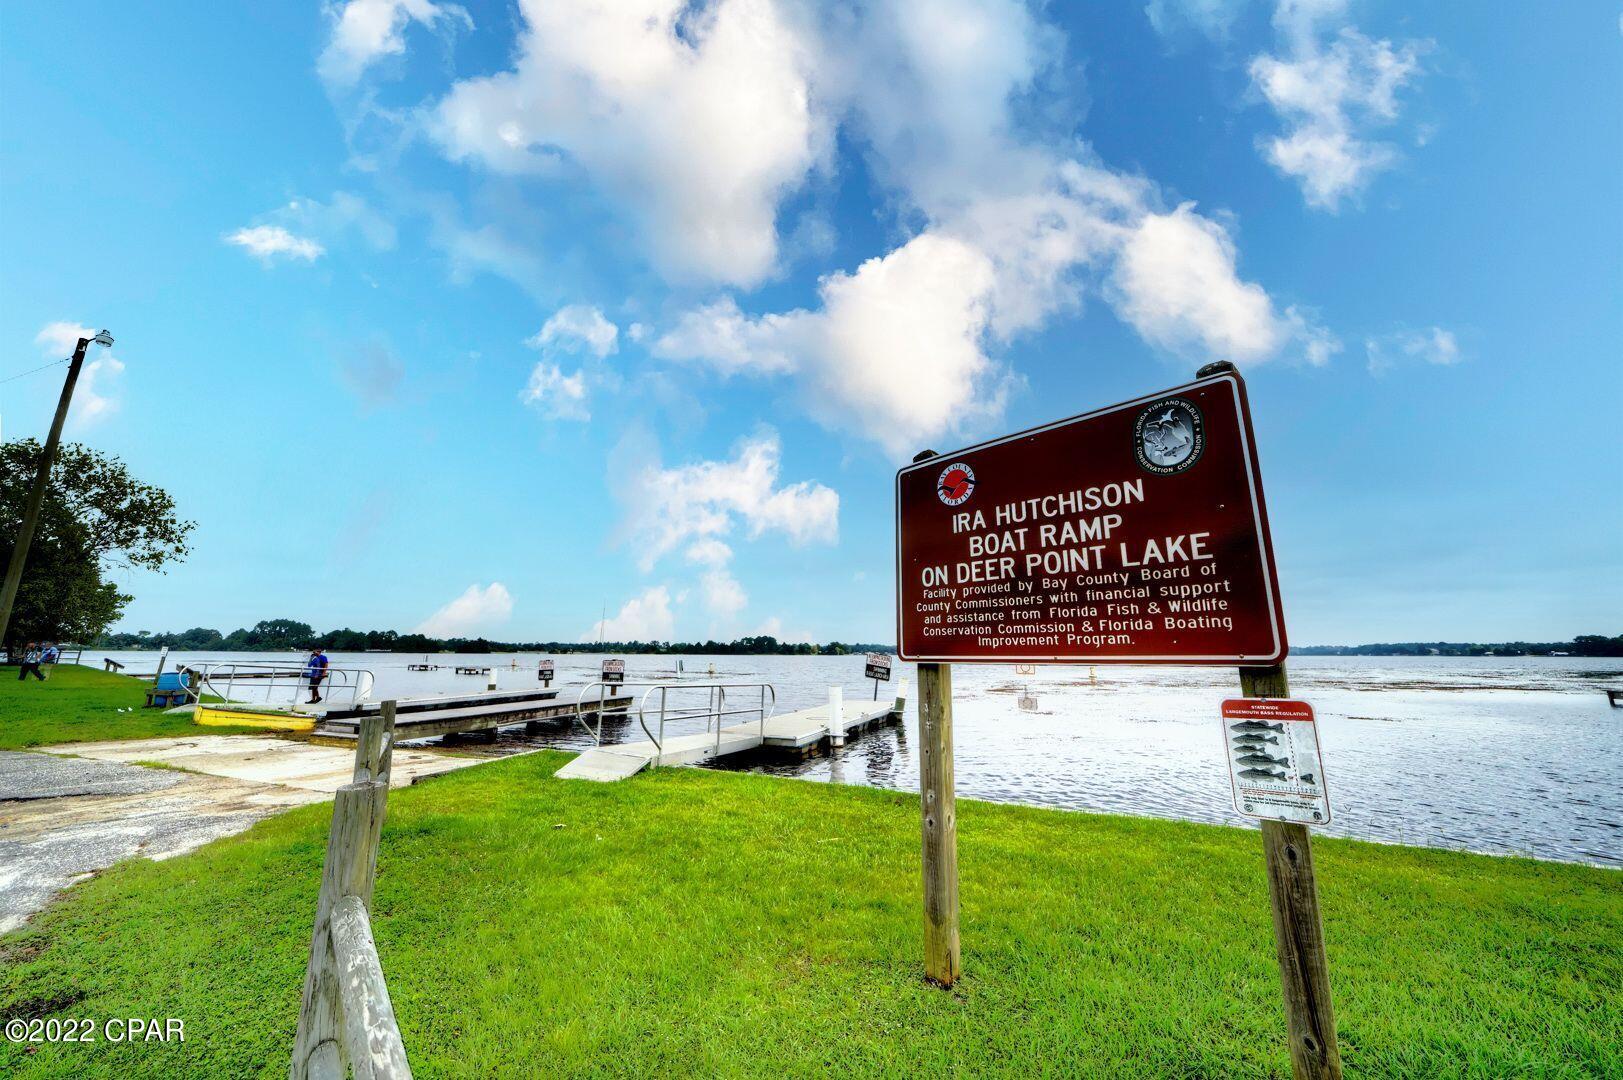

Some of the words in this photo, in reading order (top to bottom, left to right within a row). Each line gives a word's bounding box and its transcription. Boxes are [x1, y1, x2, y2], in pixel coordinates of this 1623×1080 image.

[1136, 413, 1148, 436] FLORIDA
[1148, 403, 1163, 412] FISH
[1180, 402, 1200, 424] WILDLIFE
[1137, 446, 1174, 473] CONSERVATION
[1178, 434, 1202, 470] COMMISSION
[953, 510, 986, 534] IRA
[996, 479, 1144, 526] HUTCHISON
[970, 528, 1028, 557] BOAT
[1040, 514, 1122, 548] RAMP
[922, 565, 948, 588] ON
[957, 557, 1016, 584] DEER
[1026, 545, 1106, 576] POINT
[1120, 532, 1214, 567] LAKE
[916, 602, 950, 613] County
[956, 595, 1043, 610] Commissioners
[1049, 592, 1078, 604] with
[1086, 586, 1150, 600] financial
[1160, 580, 1231, 598] support
[924, 588, 956, 600] Facility
[963, 582, 1010, 598] provided
[1018, 581, 1033, 593] by
[1042, 578, 1068, 590] Bay
[1076, 572, 1129, 586] County
[1141, 565, 1190, 580] Board
[1200, 562, 1216, 576] of
[923, 625, 992, 636] Conservation
[998, 622, 1074, 634] Commission
[1082, 620, 1094, 632] &
[1099, 619, 1153, 631] Florida
[1164, 616, 1233, 632] Boating
[924, 614, 941, 624] and
[947, 610, 1004, 622] assistance
[1012, 610, 1040, 620] from
[1050, 606, 1098, 618] Florida
[1108, 603, 1139, 616] Fish
[1148, 602, 1162, 614] &
[1168, 598, 1228, 612] Wildlife
[978, 634, 1059, 648] Improvement
[1067, 634, 1135, 648] Program.
